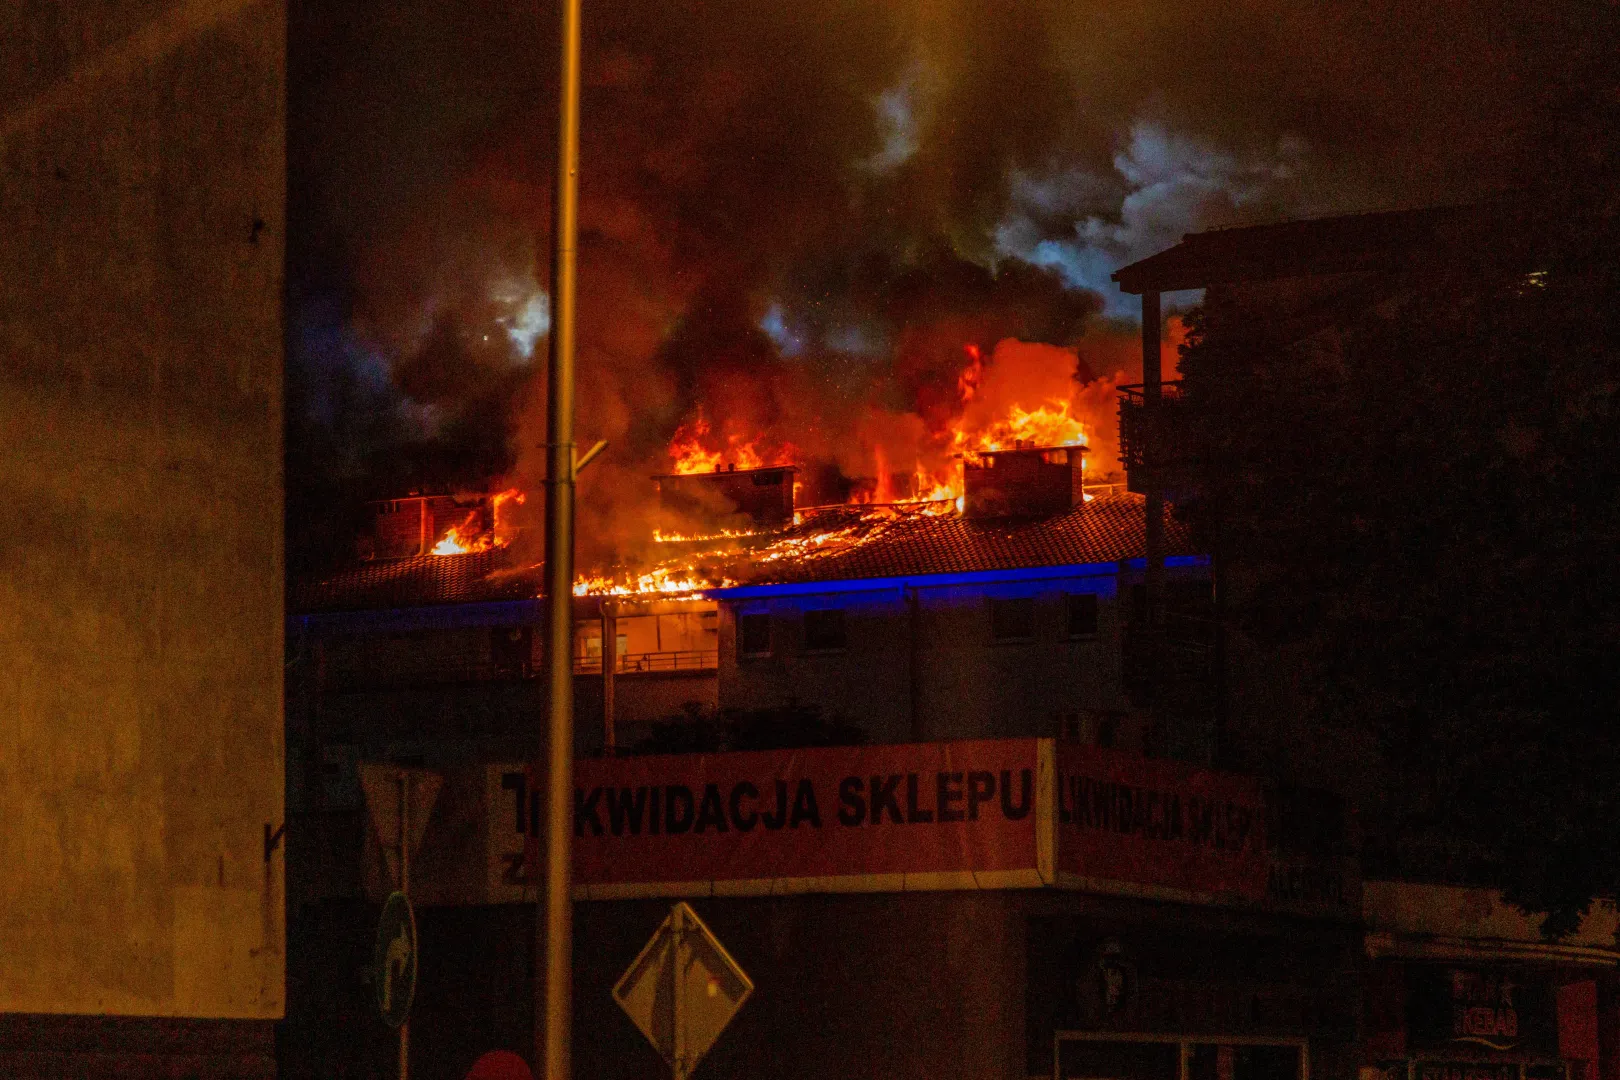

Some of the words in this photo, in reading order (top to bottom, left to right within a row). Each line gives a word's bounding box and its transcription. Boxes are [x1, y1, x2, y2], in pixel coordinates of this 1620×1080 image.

[531, 778, 821, 837] LKWIDACJA
[838, 768, 1034, 826] SKLEPU
[1453, 1004, 1517, 1037] KEBAB
